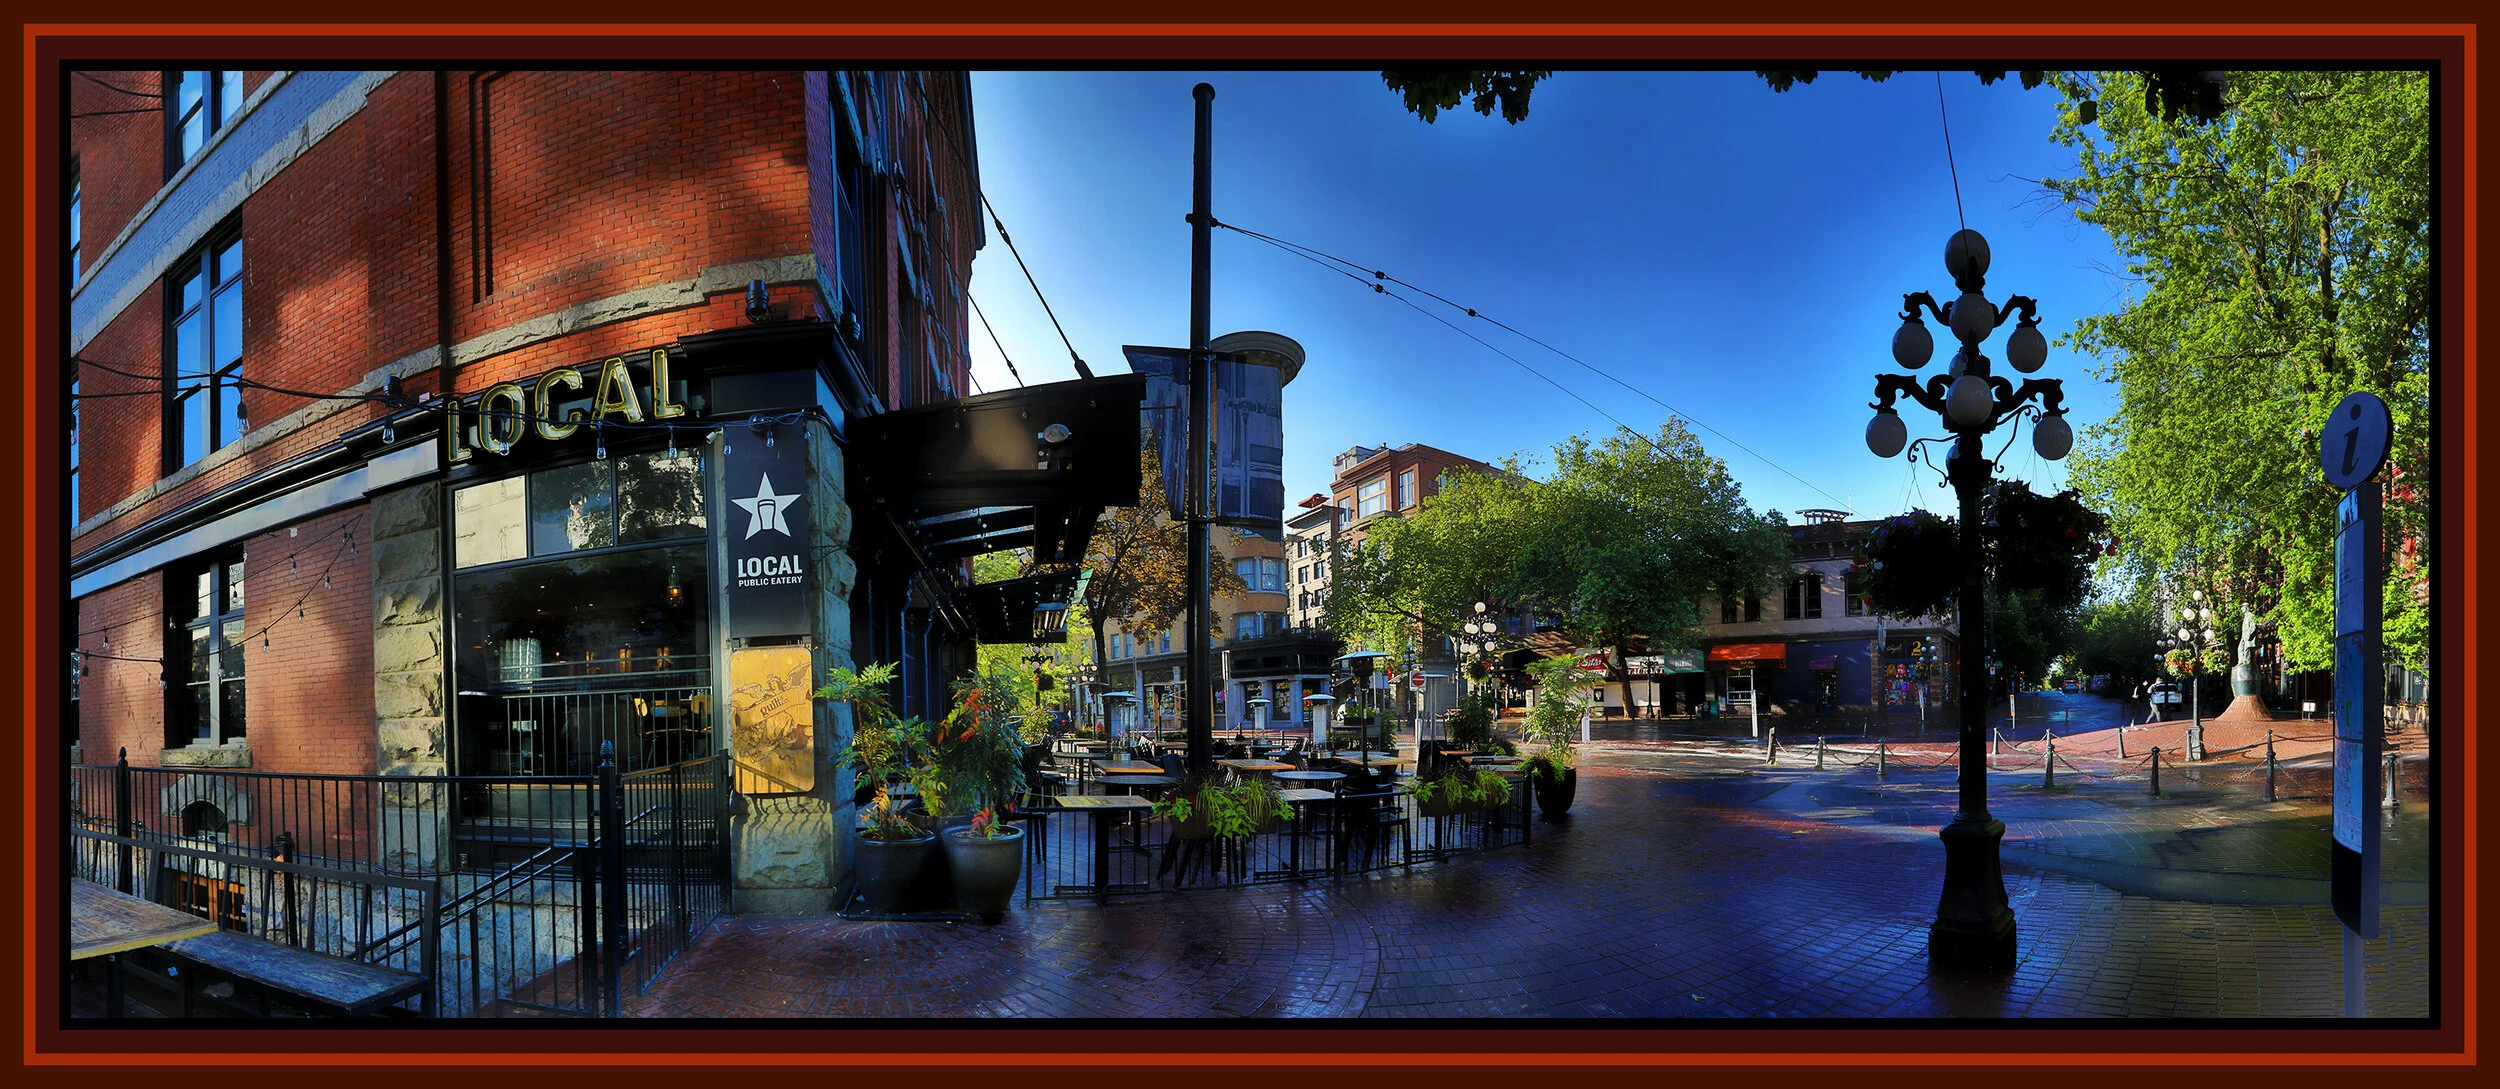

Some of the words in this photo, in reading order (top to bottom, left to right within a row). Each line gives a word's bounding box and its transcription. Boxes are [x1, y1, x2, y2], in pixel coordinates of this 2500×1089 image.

[447, 348, 686, 462] LOCAL
[738, 555, 803, 578] LOCAL
[738, 578, 769, 588] PUBLIC
[771, 576, 803, 585] EATERY
